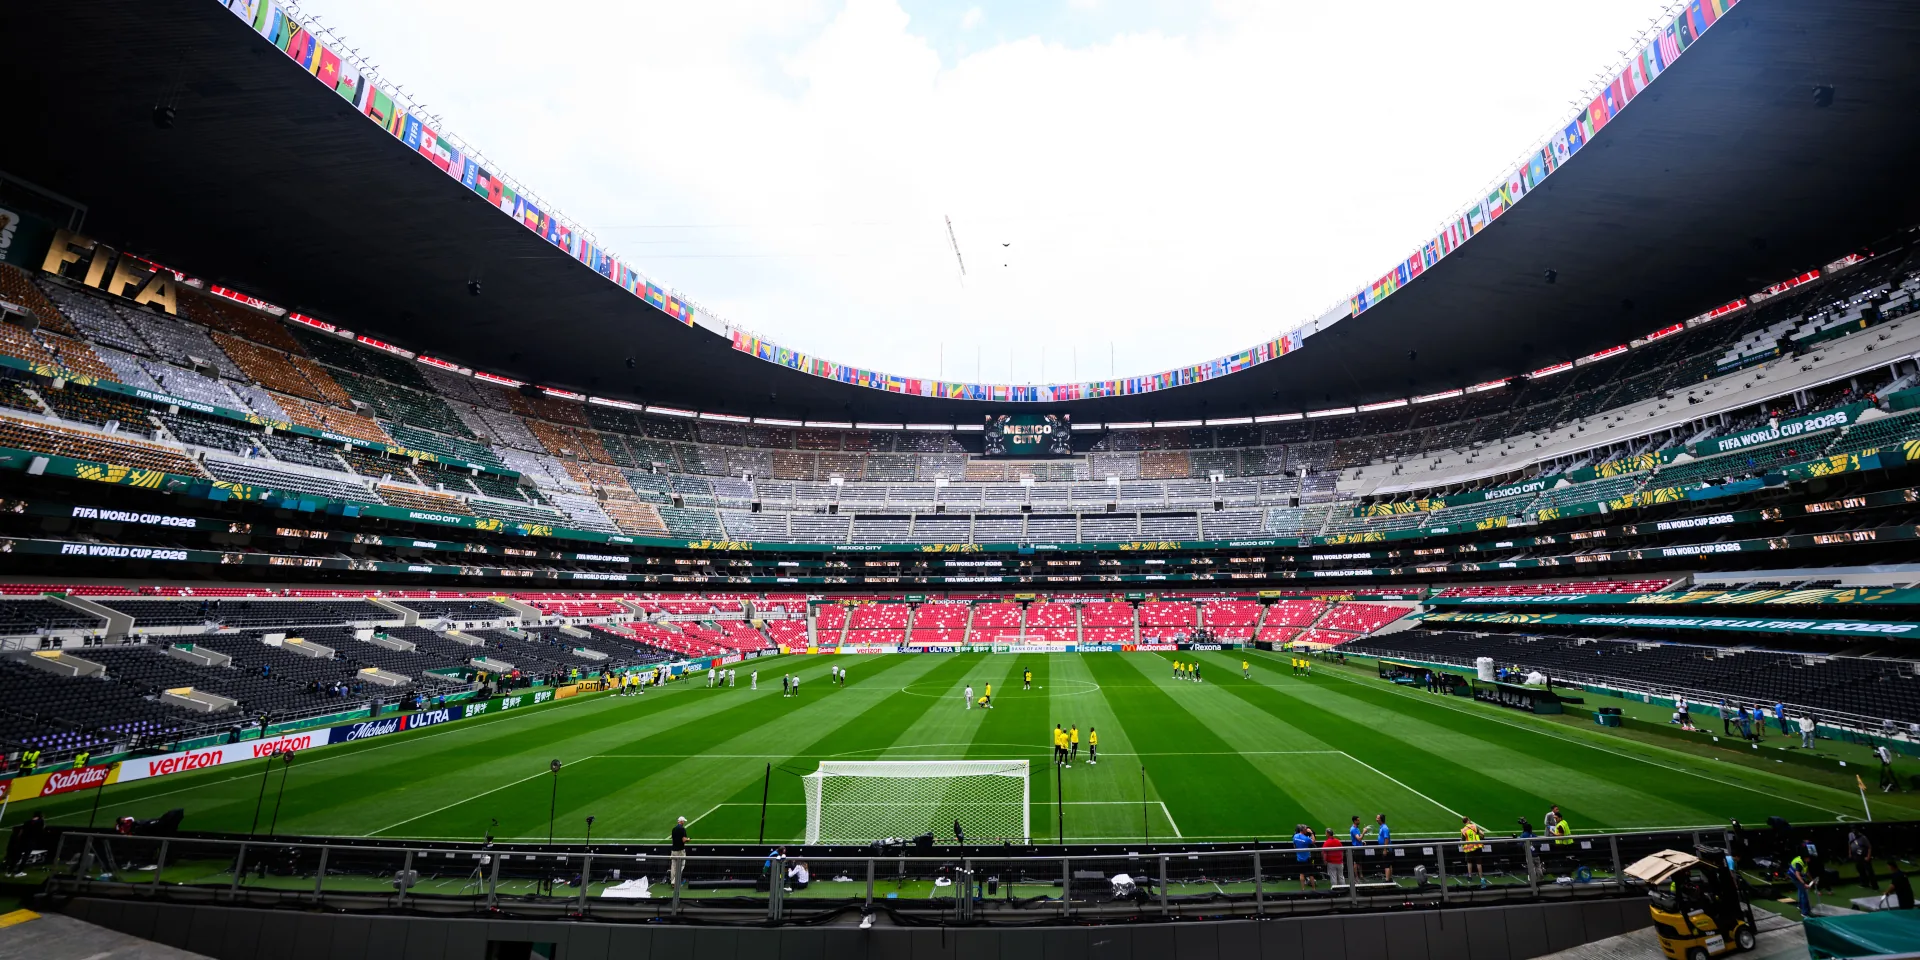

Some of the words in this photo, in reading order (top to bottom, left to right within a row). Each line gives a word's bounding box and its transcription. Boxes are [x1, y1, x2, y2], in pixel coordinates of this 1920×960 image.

[408, 122, 418, 144] FIFA
[466, 164, 474, 185] FIFA
[42, 228, 177, 316] FIFA
[136, 390, 152, 398] FIFA
[152, 394, 176, 404] WORLD
[178, 398, 191, 407] CUP
[191, 402, 214, 412] 2026
[1003, 425, 1052, 434] MEXICO
[1718, 440, 1742, 451] FIFA
[1742, 430, 1780, 445] WORLD
[1780, 422, 1803, 437] CUP
[1804, 412, 1847, 431] 2026
[322, 432, 352, 442] MEXICO
[352, 438, 370, 446] CITY
[1013, 435, 1042, 444] CITY
[1485, 486, 1522, 500] MEXICO
[1522, 481, 1545, 493] CITY
[1805, 500, 1842, 513] MEXICO
[1842, 497, 1866, 508] CITY
[72, 507, 97, 519] FIFA
[99, 509, 139, 522] WORLD
[140, 514, 161, 524] CUP
[161, 516, 196, 528] 2026
[410, 512, 442, 521] MEXICO
[442, 515, 461, 523] CITY
[1657, 522, 1671, 530] FIFA
[1671, 520, 1694, 529] WORLD
[1695, 518, 1708, 526] CUP
[1708, 515, 1734, 525] 2026
[276, 528, 308, 538] MEXICO
[309, 531, 328, 539] CITY
[1571, 532, 1592, 540] MEXICO
[1814, 533, 1850, 544] MEXICO
[1852, 530, 1876, 541] CITY
[61, 544, 87, 555] FIFA
[89, 545, 129, 557] WORLD
[130, 548, 152, 558] CUP
[151, 550, 187, 560] 2026
[1677, 546, 1700, 555] WORLD
[1701, 545, 1714, 553] CUP
[1715, 543, 1741, 552] 2026
[269, 557, 302, 566] MEXICO
[304, 558, 322, 567] CITY
[1810, 623, 1918, 633] 2026
[347, 718, 398, 742] Michelob
[410, 709, 449, 728] ULTRA
[253, 736, 311, 758] verizon
[149, 750, 222, 776] verizon
[44, 767, 108, 794] Sabritas
